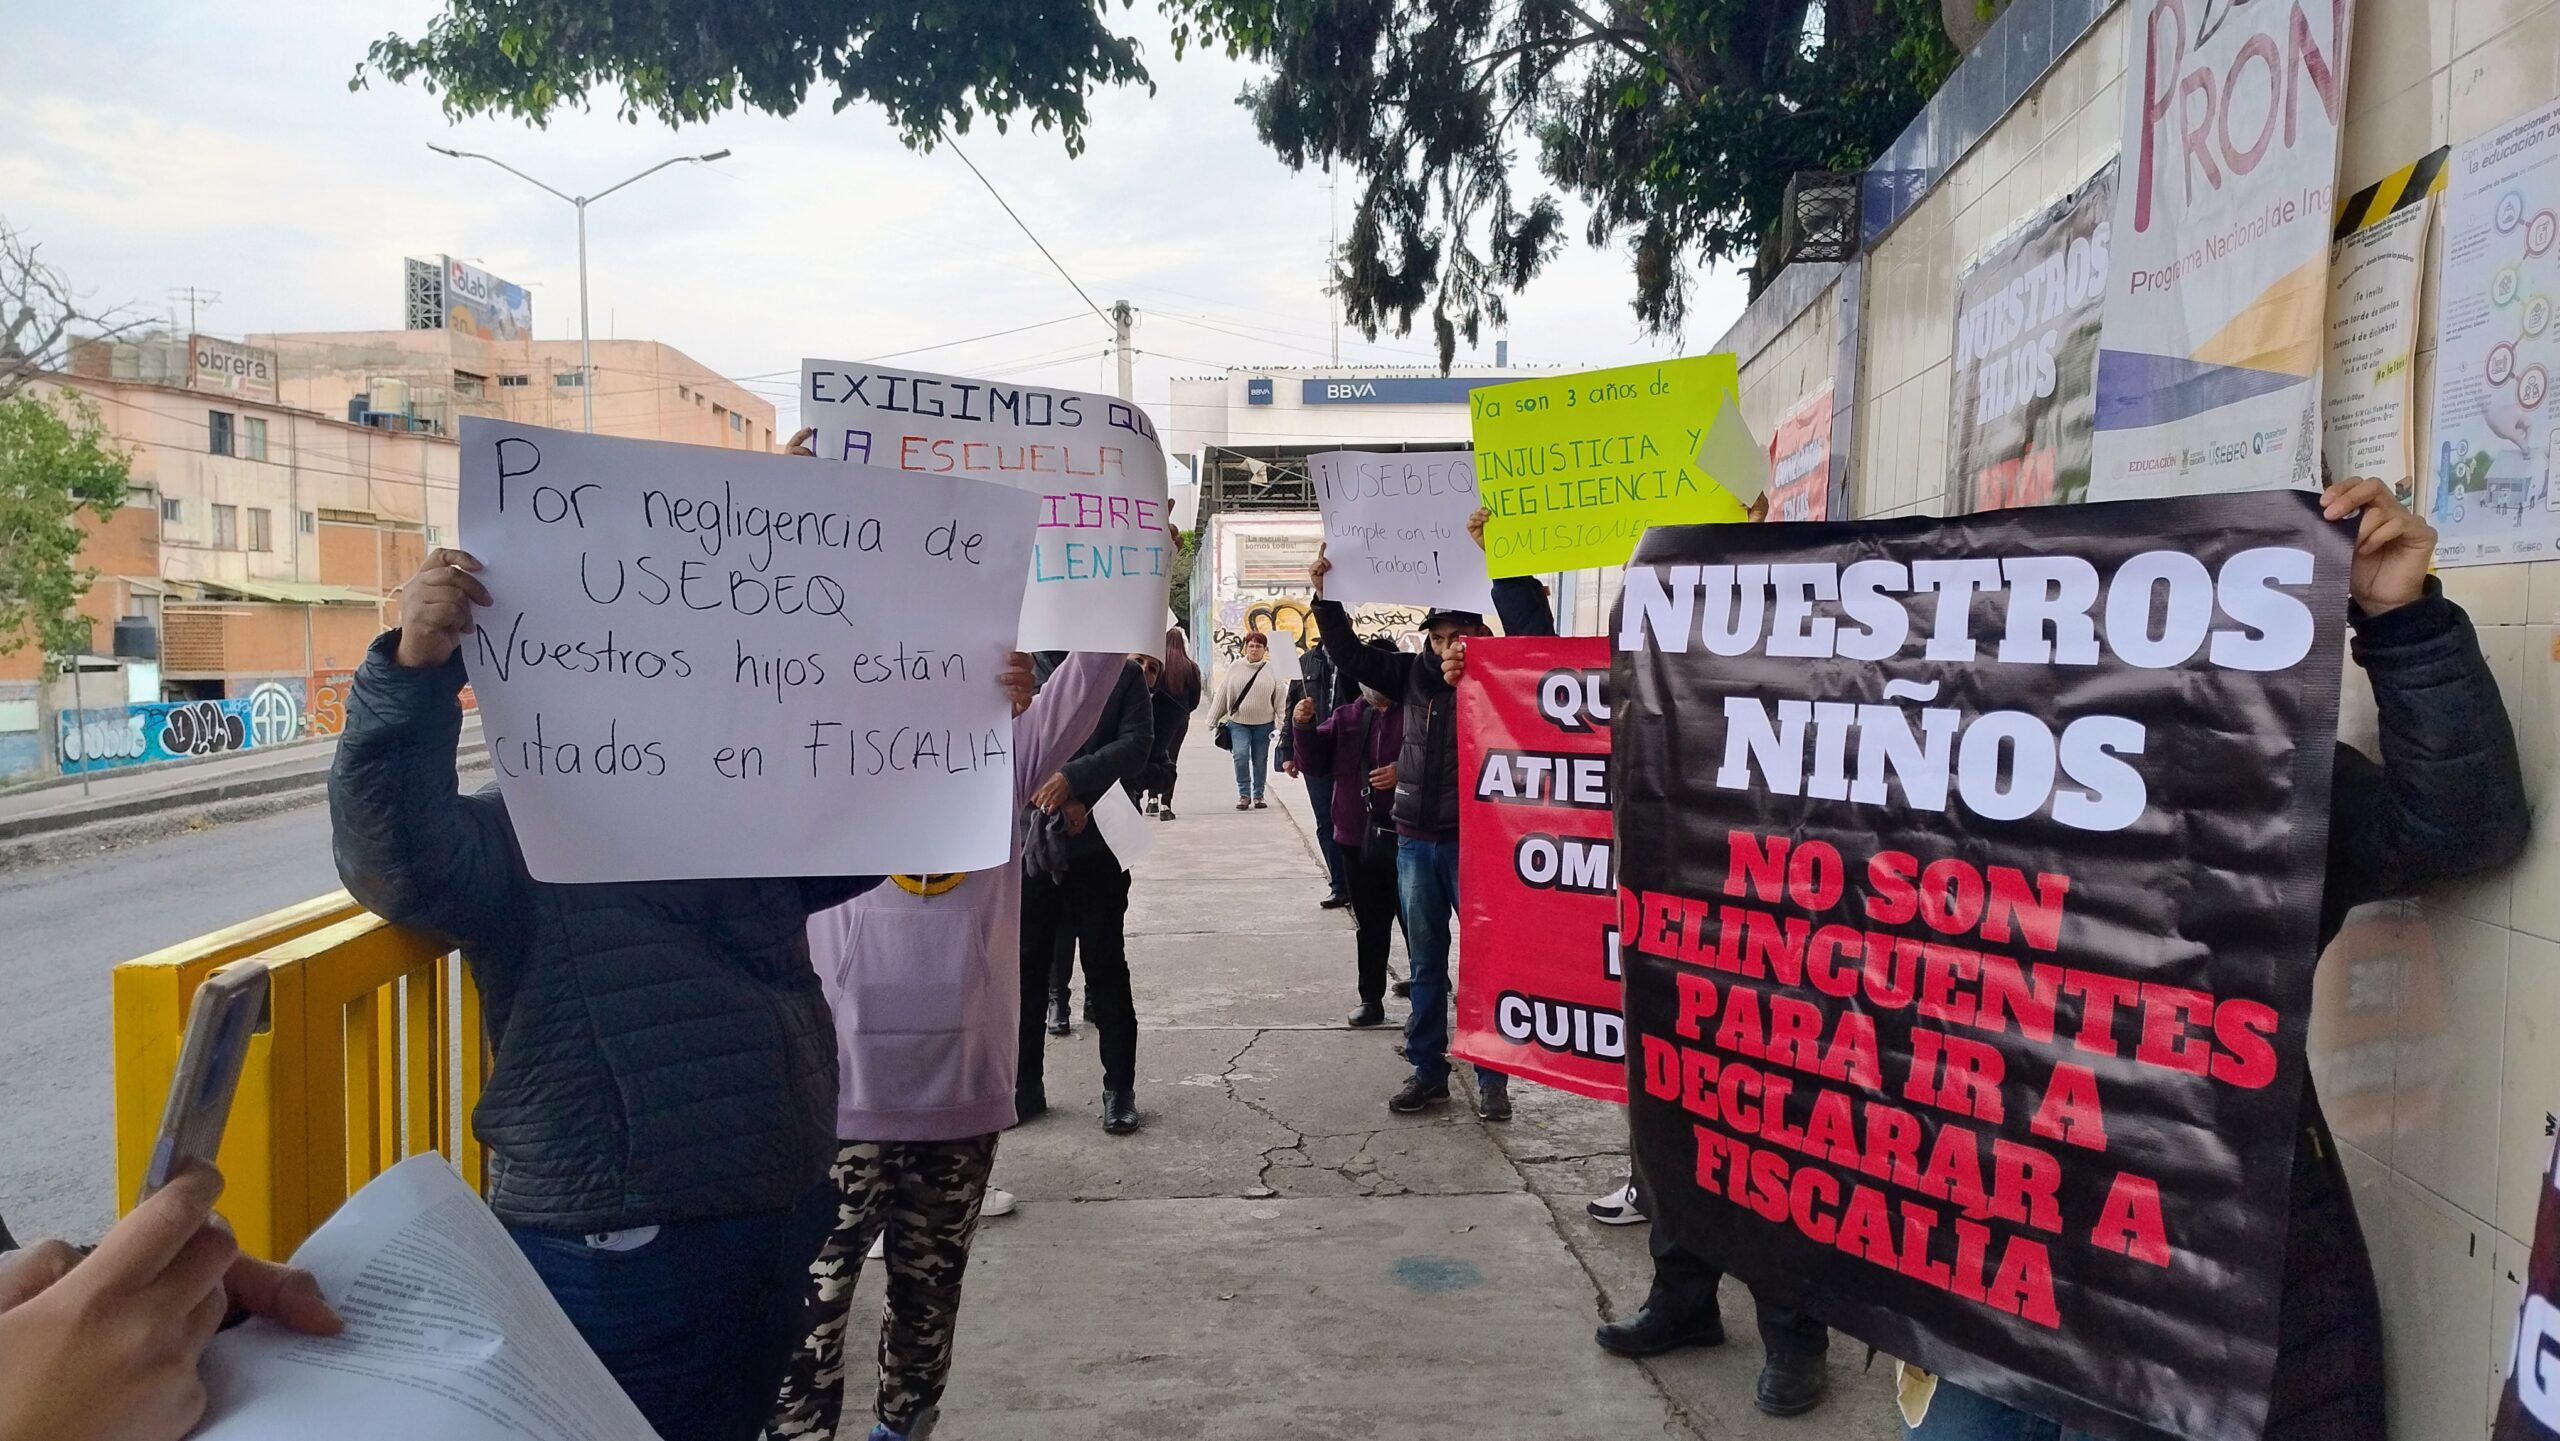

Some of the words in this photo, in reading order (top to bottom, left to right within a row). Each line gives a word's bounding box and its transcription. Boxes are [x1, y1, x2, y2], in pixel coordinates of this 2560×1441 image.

[2469, 159, 2479, 175] la
[2481, 130, 2545, 169] educación
[2495, 111, 2551, 148] aportaciones
[2130, 249, 2203, 295] Programa
[2205, 207, 2270, 264] Nacional
[2271, 196, 2297, 229] de
[1956, 221, 2112, 373] NUESTROS
[811, 371, 1083, 428] EXIGIMOS
[1250, 387, 1270, 396] BBVA
[1327, 383, 1377, 399] BBVA
[1473, 392, 1501, 420] Ya
[1515, 394, 1550, 413] son
[1566, 388, 1578, 408] 3
[1588, 382, 1638, 405] años
[1649, 368, 1671, 397] de
[1976, 329, 2058, 426] HIJOS
[900, 435, 1127, 477] ESCUELA
[1479, 433, 1660, 482] INJUSTICIA
[2128, 453, 2177, 472] EDUCACIÓN
[2208, 441, 2248, 466] USEBEQ
[495, 437, 602, 529] Por
[642, 480, 884, 573] negligencia
[925, 518, 982, 565] de
[1330, 511, 1386, 551] Cumple
[1396, 527, 1425, 541] con
[1431, 521, 1452, 540] tu
[580, 550, 853, 627] USEBEQ
[1618, 546, 2317, 674] NUESTROS
[475, 611, 693, 682] Nuestros
[734, 637, 826, 705] hijos
[852, 640, 967, 684] están
[713, 742, 763, 780] en
[803, 719, 1008, 778] FISCALIA
[1716, 677, 2148, 833] NIÑOS
[1724, 831, 1844, 914] NO
[1865, 849, 2070, 951] SON
[1621, 885, 2279, 1092] DELINCUENTES
[1675, 971, 1884, 1092] PARA
[1903, 1026, 2005, 1125] IR
[2030, 1062, 2107, 1152] A
[1642, 1034, 2064, 1235] DECLARAR
[2091, 1171, 2171, 1268] A
[1692, 1125, 2062, 1330] FISCALÍA
